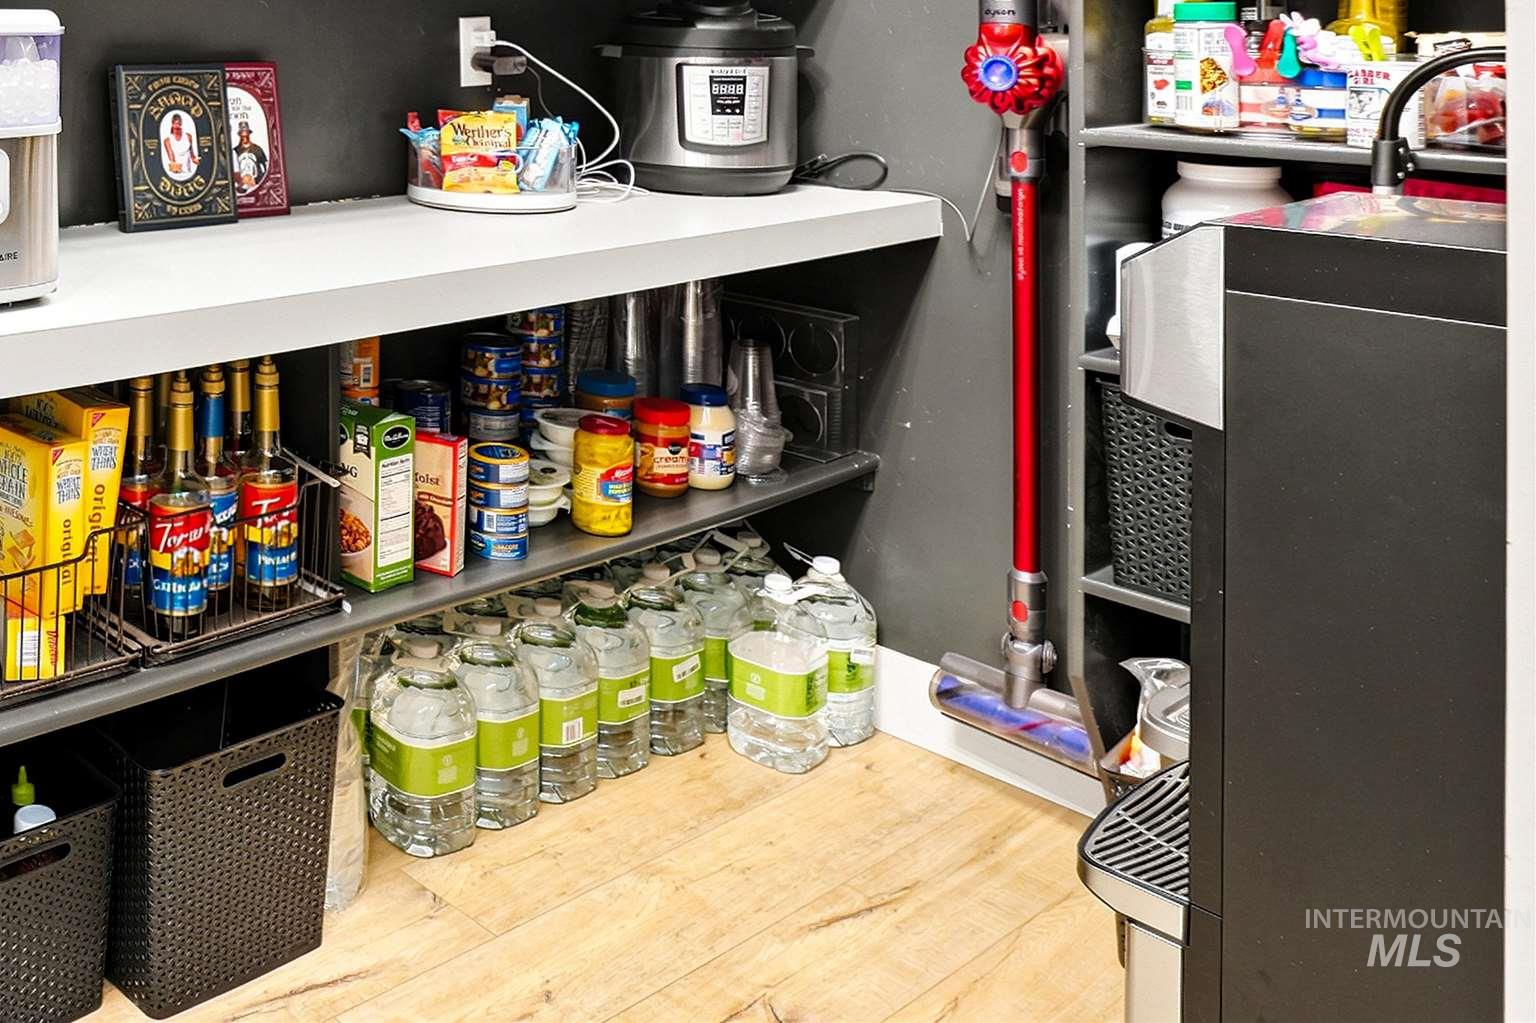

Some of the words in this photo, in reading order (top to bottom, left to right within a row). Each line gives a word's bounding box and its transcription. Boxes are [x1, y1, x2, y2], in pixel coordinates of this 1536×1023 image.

[985, 8, 1016, 17] dyson
[450, 122, 512, 138] Werther's
[465, 135, 511, 148] Original
[60, 518, 73, 586] origial
